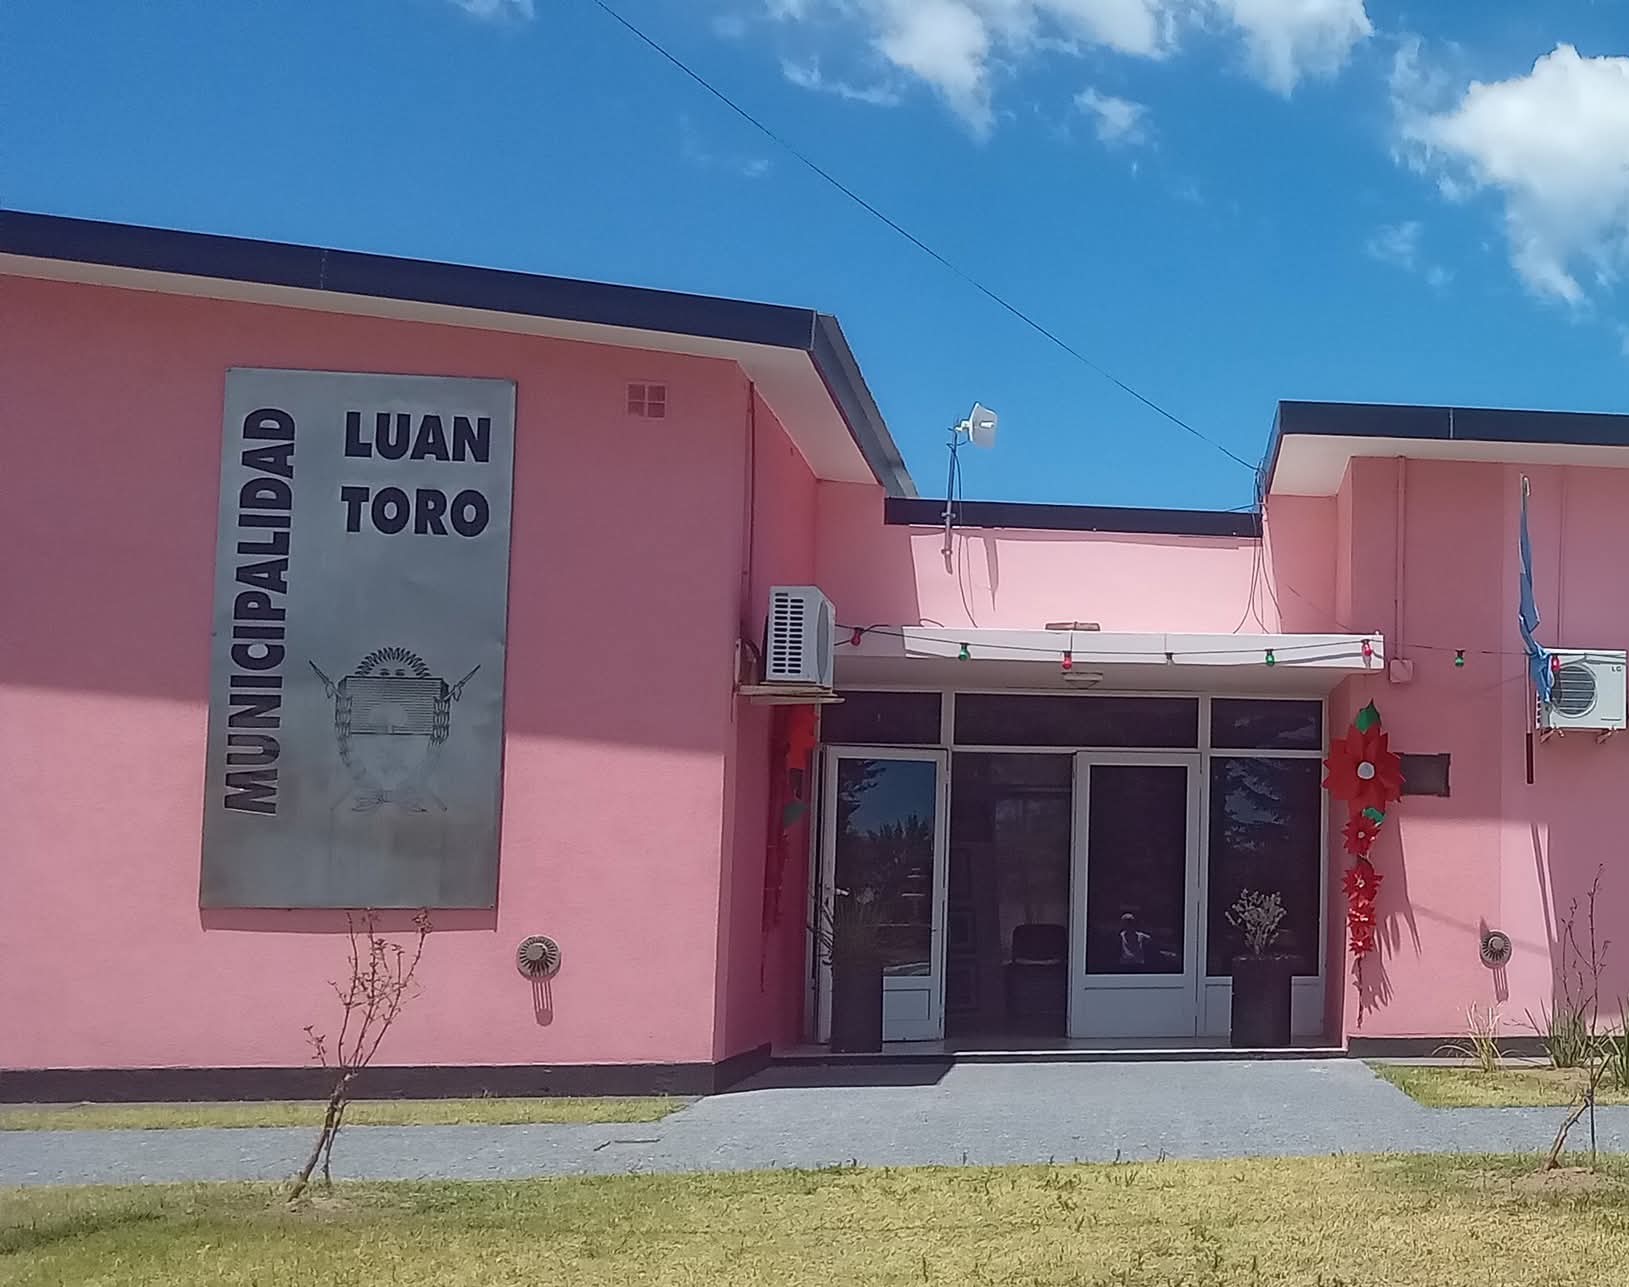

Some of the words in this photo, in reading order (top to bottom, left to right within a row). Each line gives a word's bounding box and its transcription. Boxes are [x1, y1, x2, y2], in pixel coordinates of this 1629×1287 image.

[344, 411, 491, 463] LUAN
[341, 486, 490, 538] TORO
[224, 407, 296, 815] MUNICIPALIDAD
[1611, 665, 1622, 673] LG
